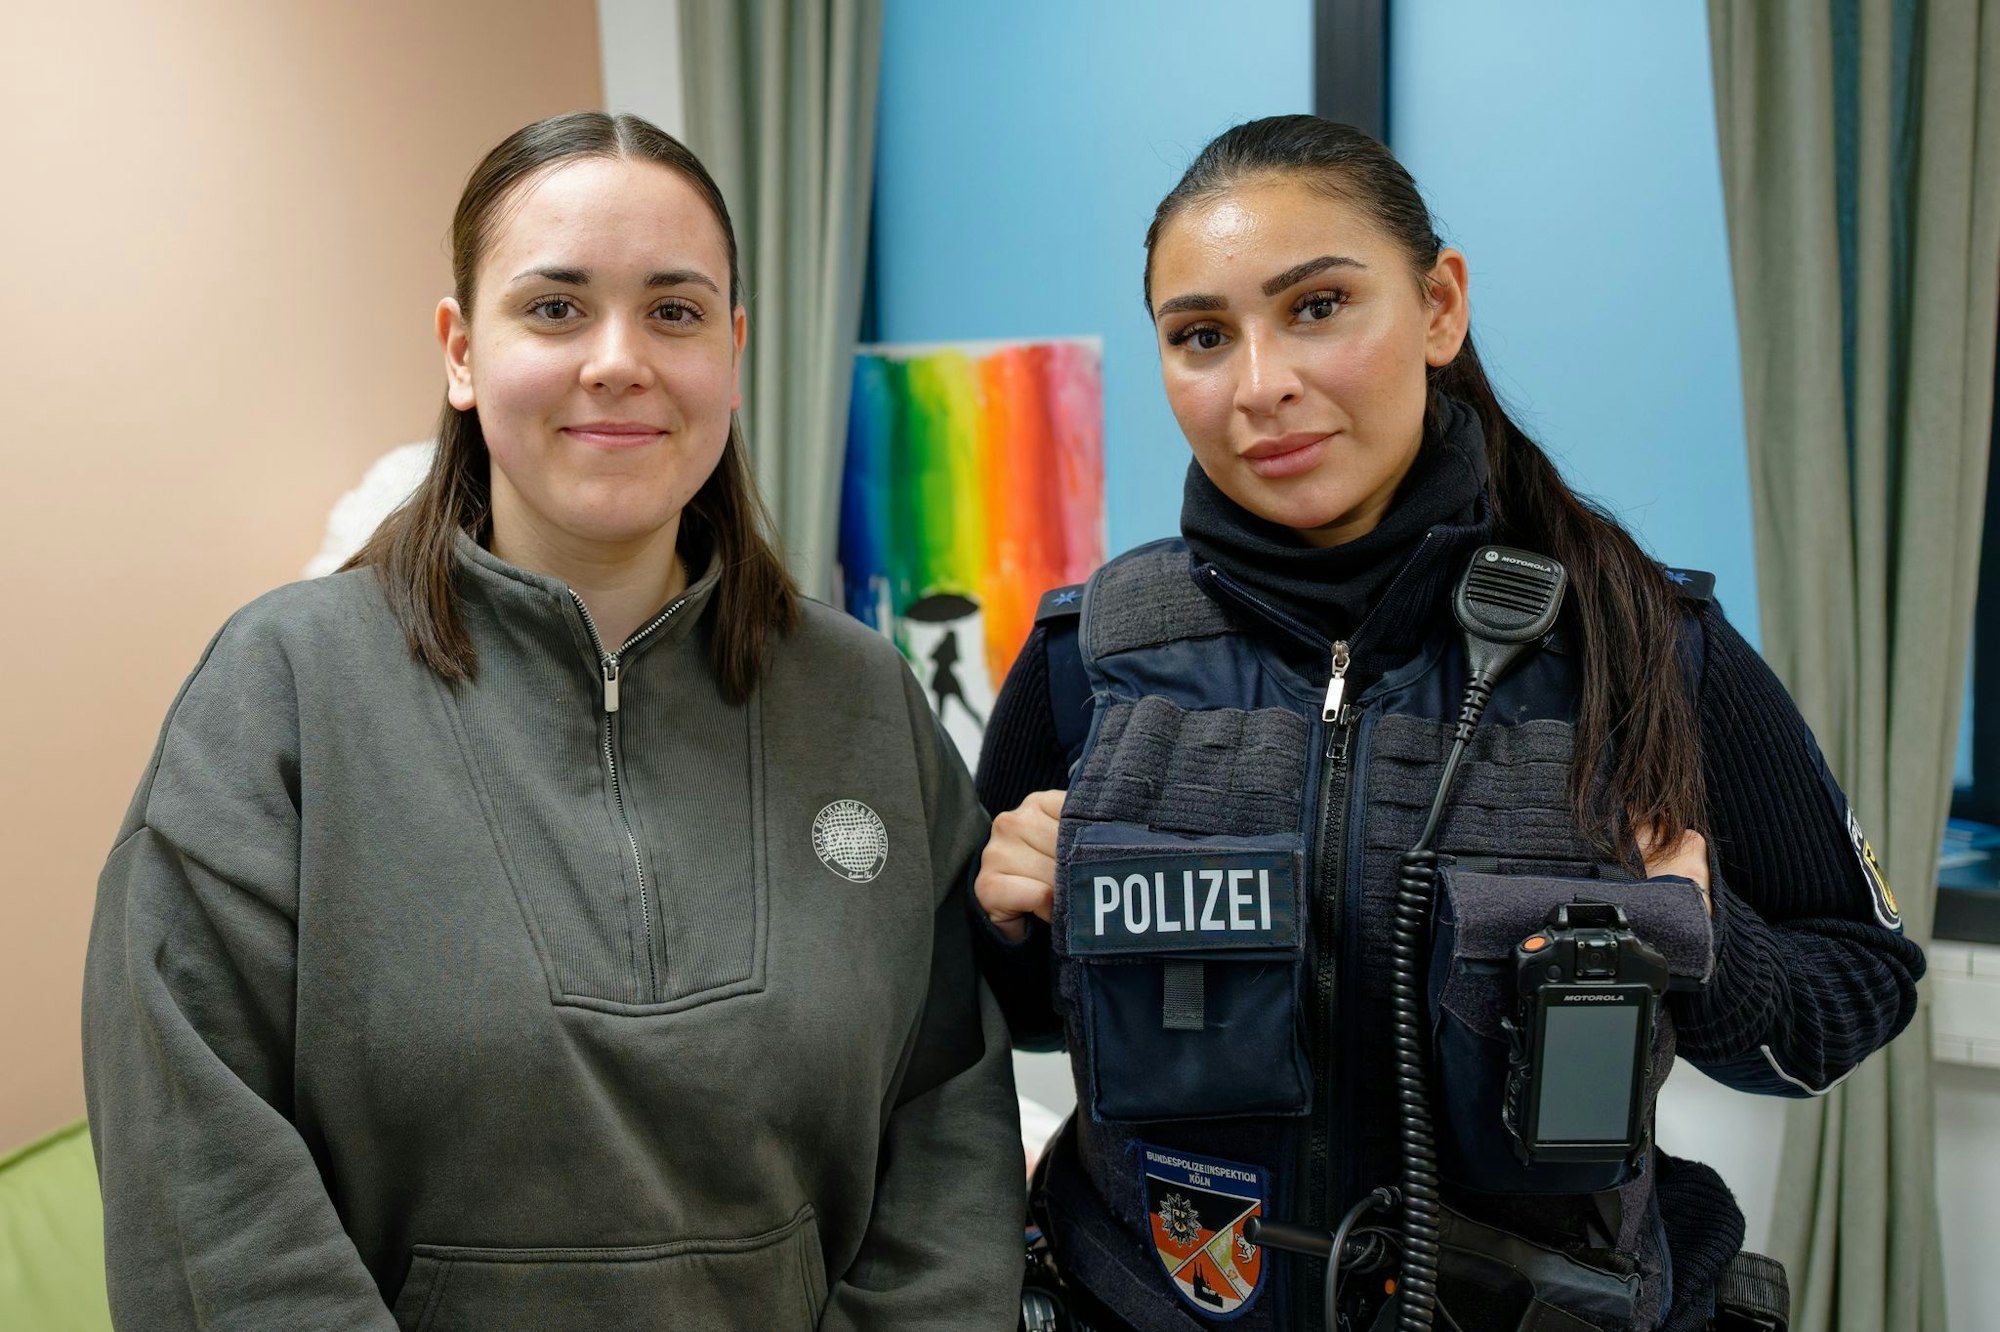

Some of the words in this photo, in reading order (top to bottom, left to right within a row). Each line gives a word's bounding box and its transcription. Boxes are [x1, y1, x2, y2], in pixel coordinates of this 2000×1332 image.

[1501, 556, 1552, 573] MOTOROLA
[815, 802, 861, 830] RECHARGE
[814, 831, 832, 862] RELAX
[865, 810, 887, 860] ENERGISE
[1093, 869, 1272, 936] POLIZEI
[1188, 1172, 1211, 1187] KÖLN
